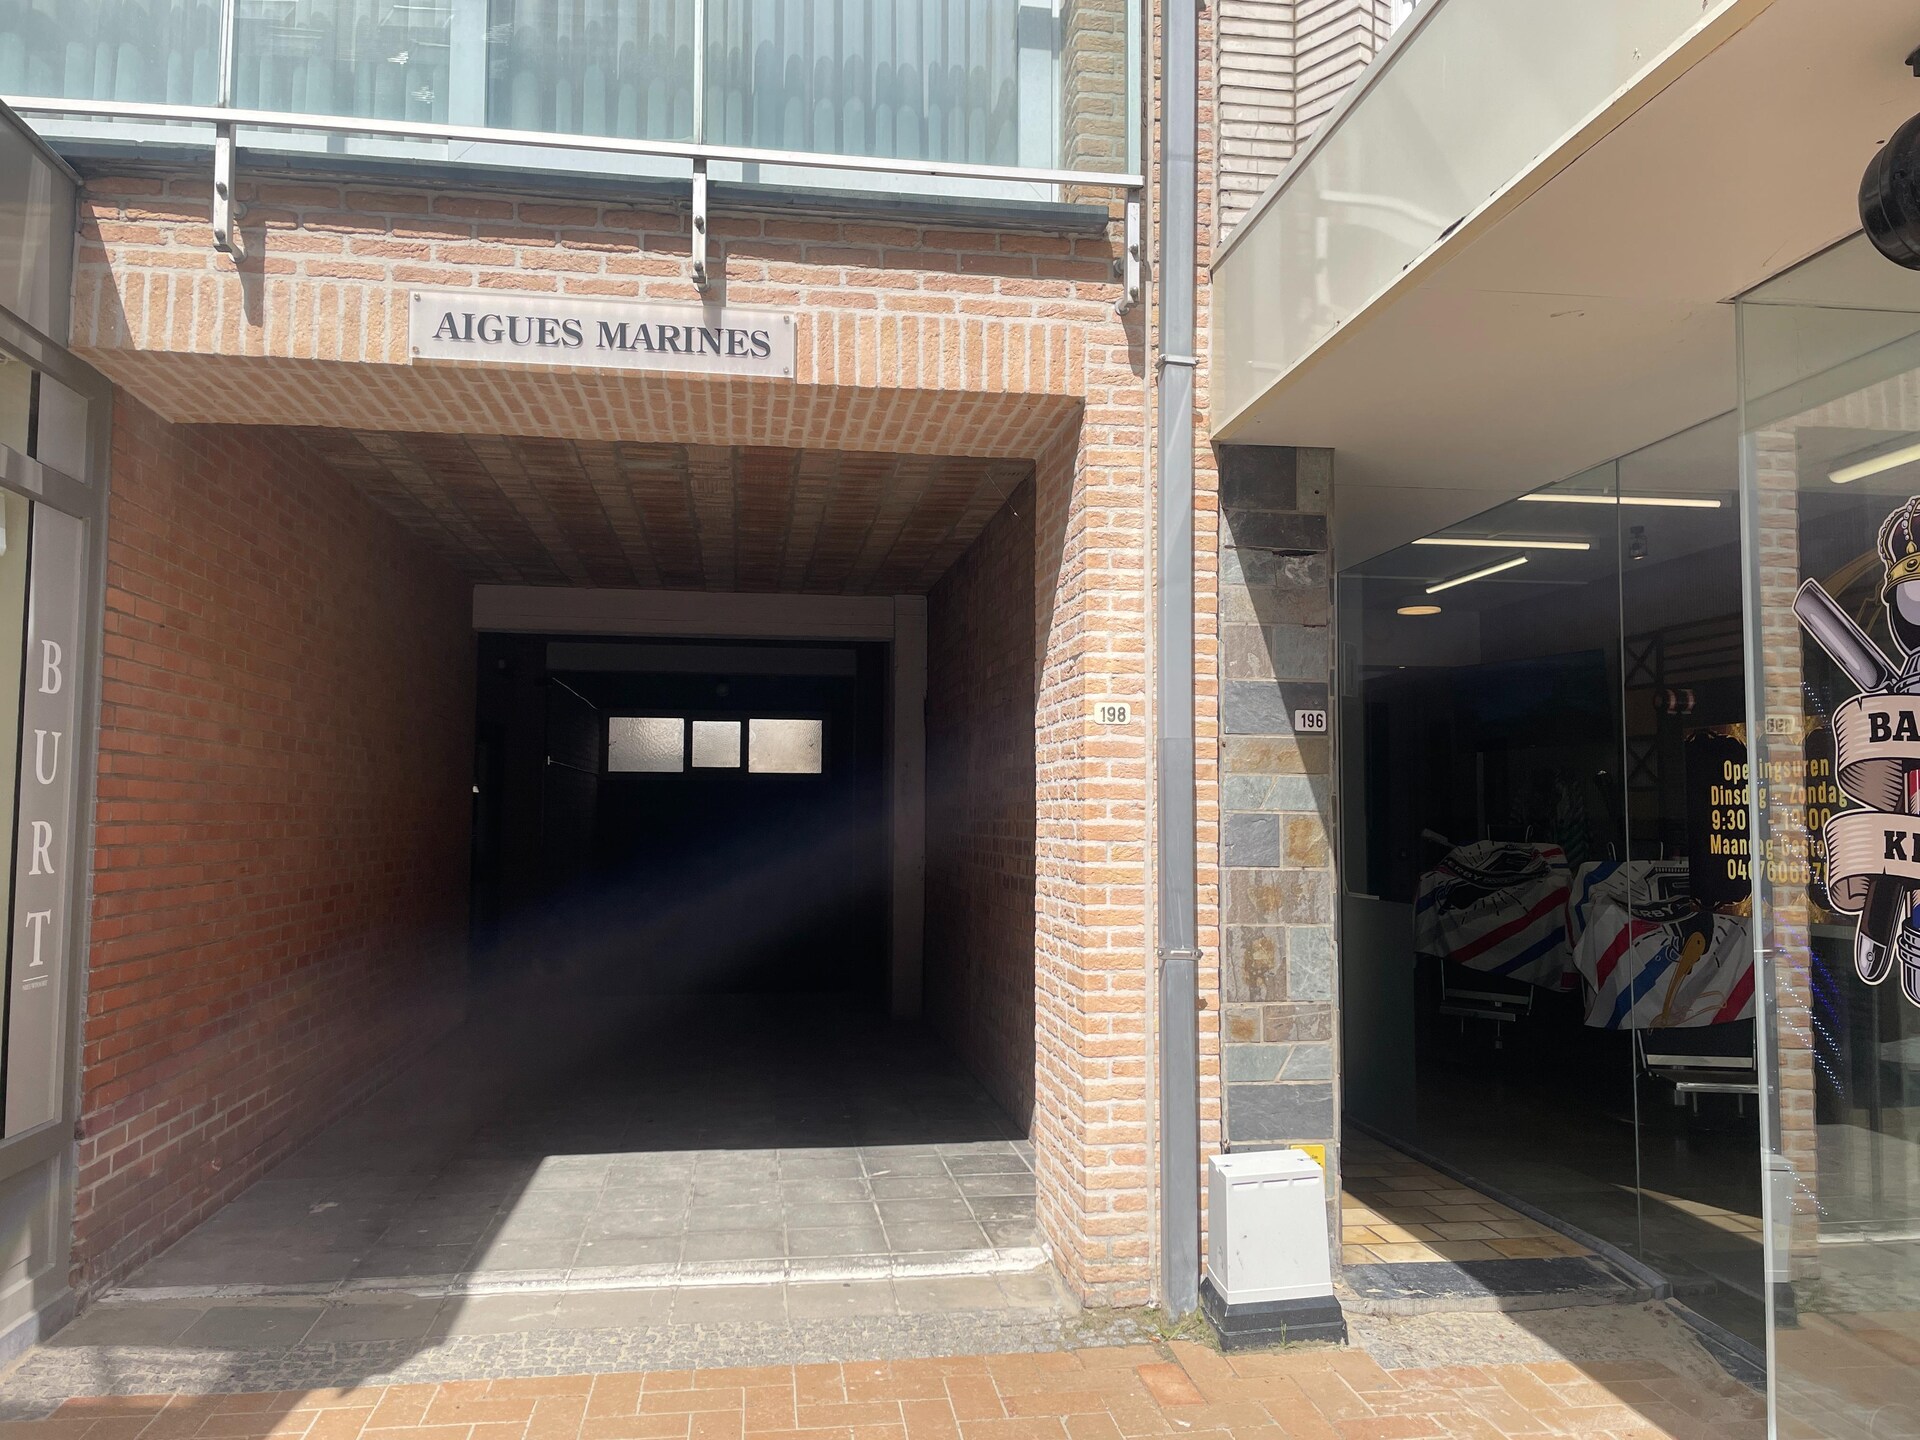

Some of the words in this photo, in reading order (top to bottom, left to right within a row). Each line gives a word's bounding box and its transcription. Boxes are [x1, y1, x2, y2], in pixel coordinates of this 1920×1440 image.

[433, 312, 583, 348] AIGUES
[596, 320, 771, 359] MARINES
[1100, 706, 1127, 723] 198
[1300, 713, 1324, 728] 196
[1723, 758, 1829, 784] Opeingsuren
[25, 639, 62, 967] BURT
[1710, 784, 1767, 809] Dinsdg
[1789, 781, 1848, 808] Zondag
[1711, 809, 1746, 830] 9:30
[1710, 834, 1774, 860] Maang
